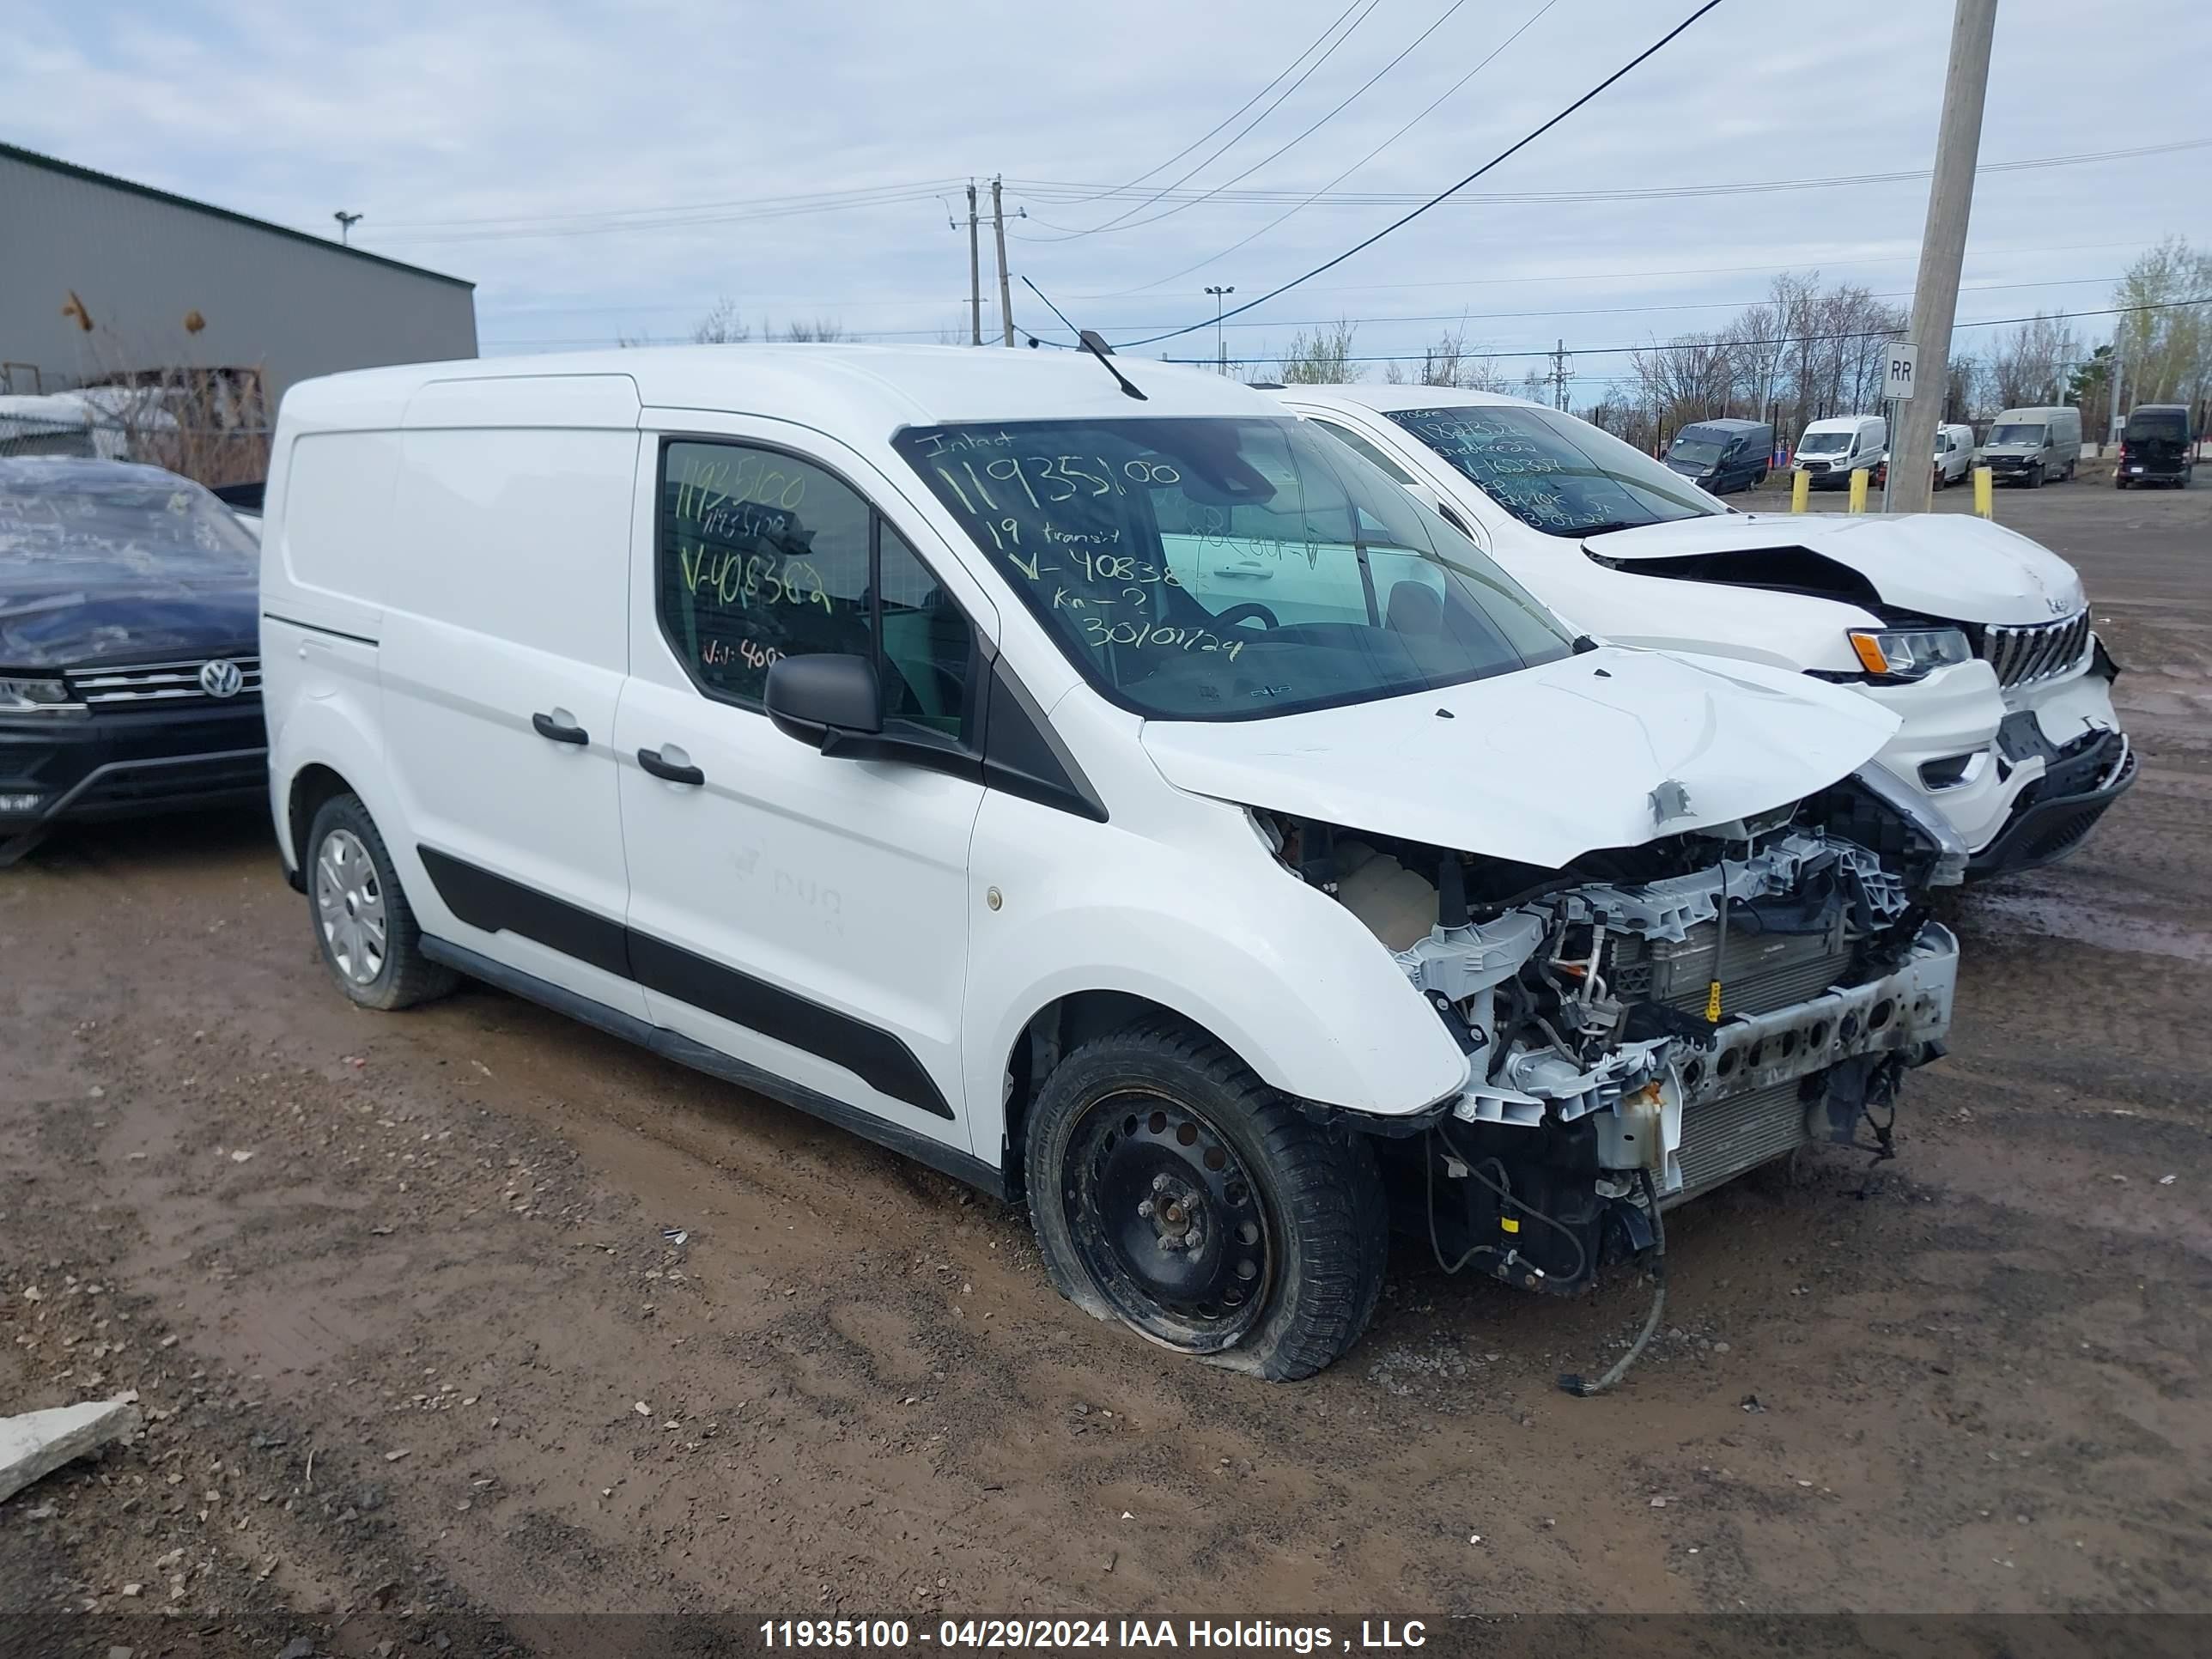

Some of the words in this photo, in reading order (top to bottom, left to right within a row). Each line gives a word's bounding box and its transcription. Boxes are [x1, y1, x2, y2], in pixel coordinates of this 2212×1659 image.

[1891, 361, 1911, 381] RR
[915, 432, 1018, 459] Intact
[937, 455, 1181, 514] 11935100
[987, 519, 1021, 550] 19
